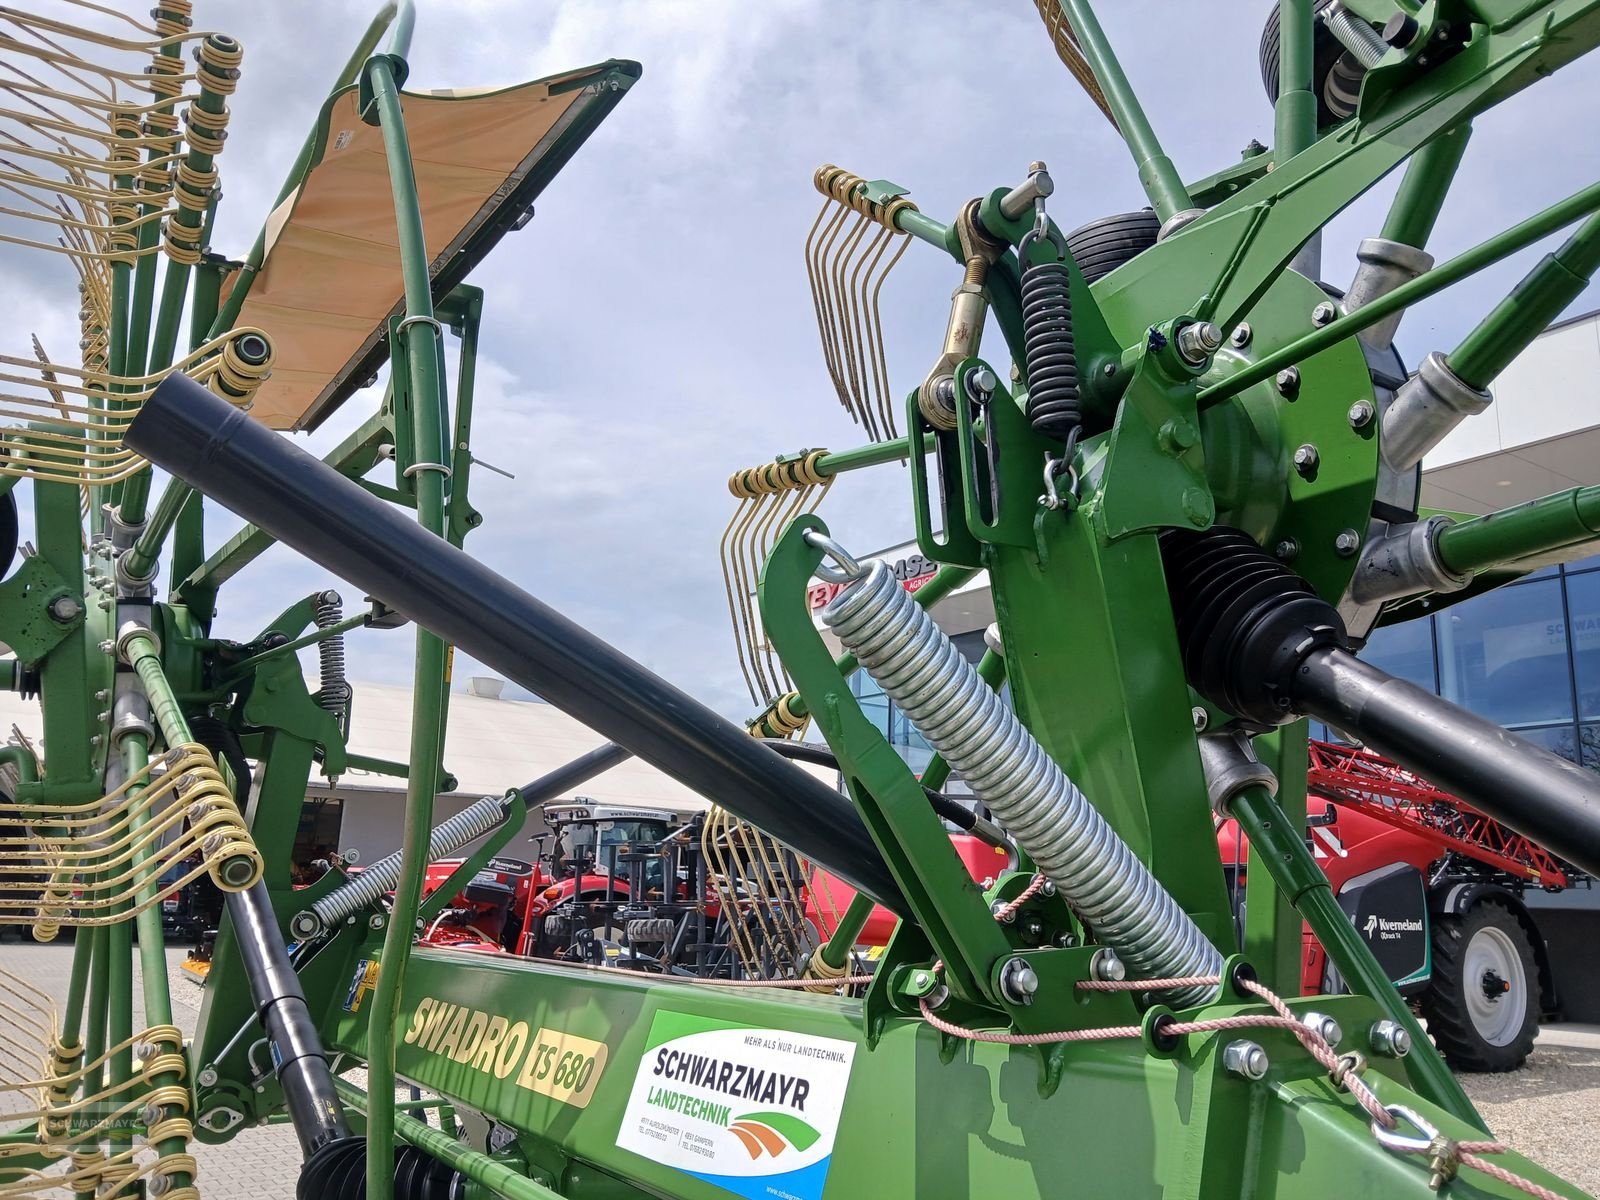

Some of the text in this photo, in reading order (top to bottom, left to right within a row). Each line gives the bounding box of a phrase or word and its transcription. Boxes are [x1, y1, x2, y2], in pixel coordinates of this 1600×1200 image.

[1379, 918, 1423, 931] Kverneland
[404, 996, 595, 1094] SWADRO TS 680
[744, 1035, 846, 1064] MEHR ALS NUR LANDTECHNIK.
[653, 1047, 810, 1111] SCHWARZMAYR
[647, 1085, 732, 1127] LANDTECHNIK
